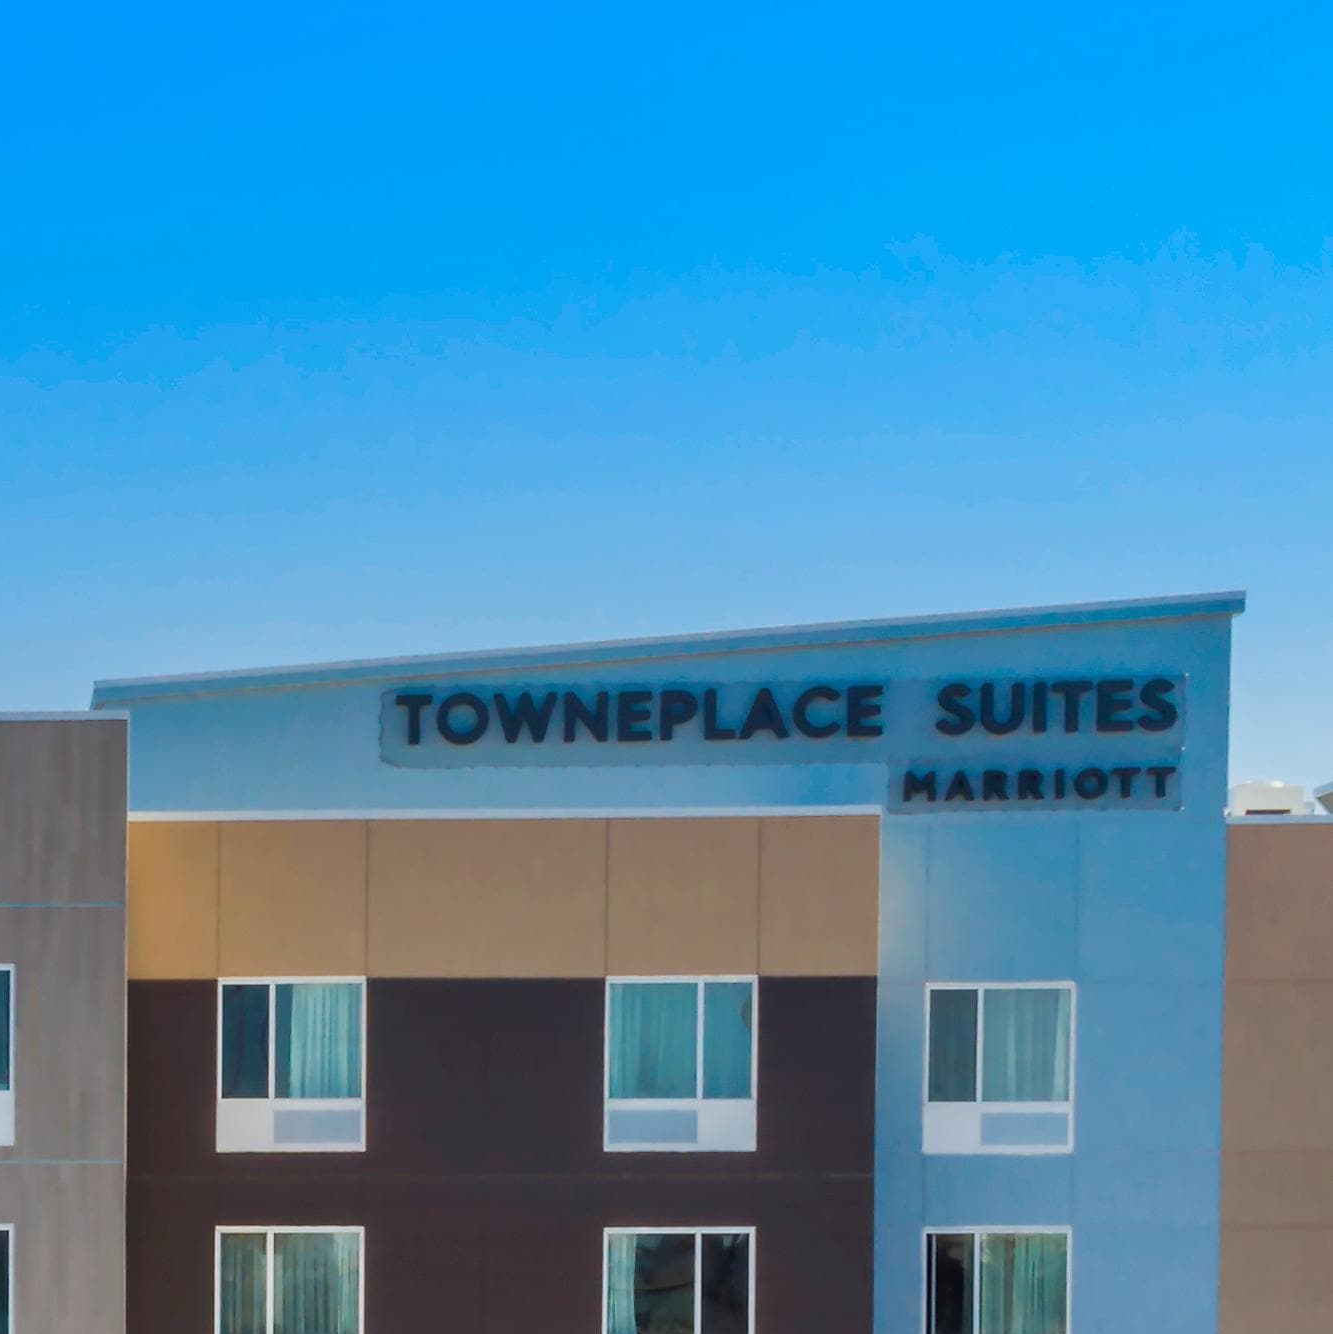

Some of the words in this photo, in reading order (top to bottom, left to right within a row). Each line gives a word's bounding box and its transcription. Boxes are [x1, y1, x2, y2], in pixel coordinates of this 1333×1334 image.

[395, 685, 884, 746] TOWNEPLACE
[935, 678, 1178, 736] SUITES
[902, 766, 1177, 802] MARRIOTT
